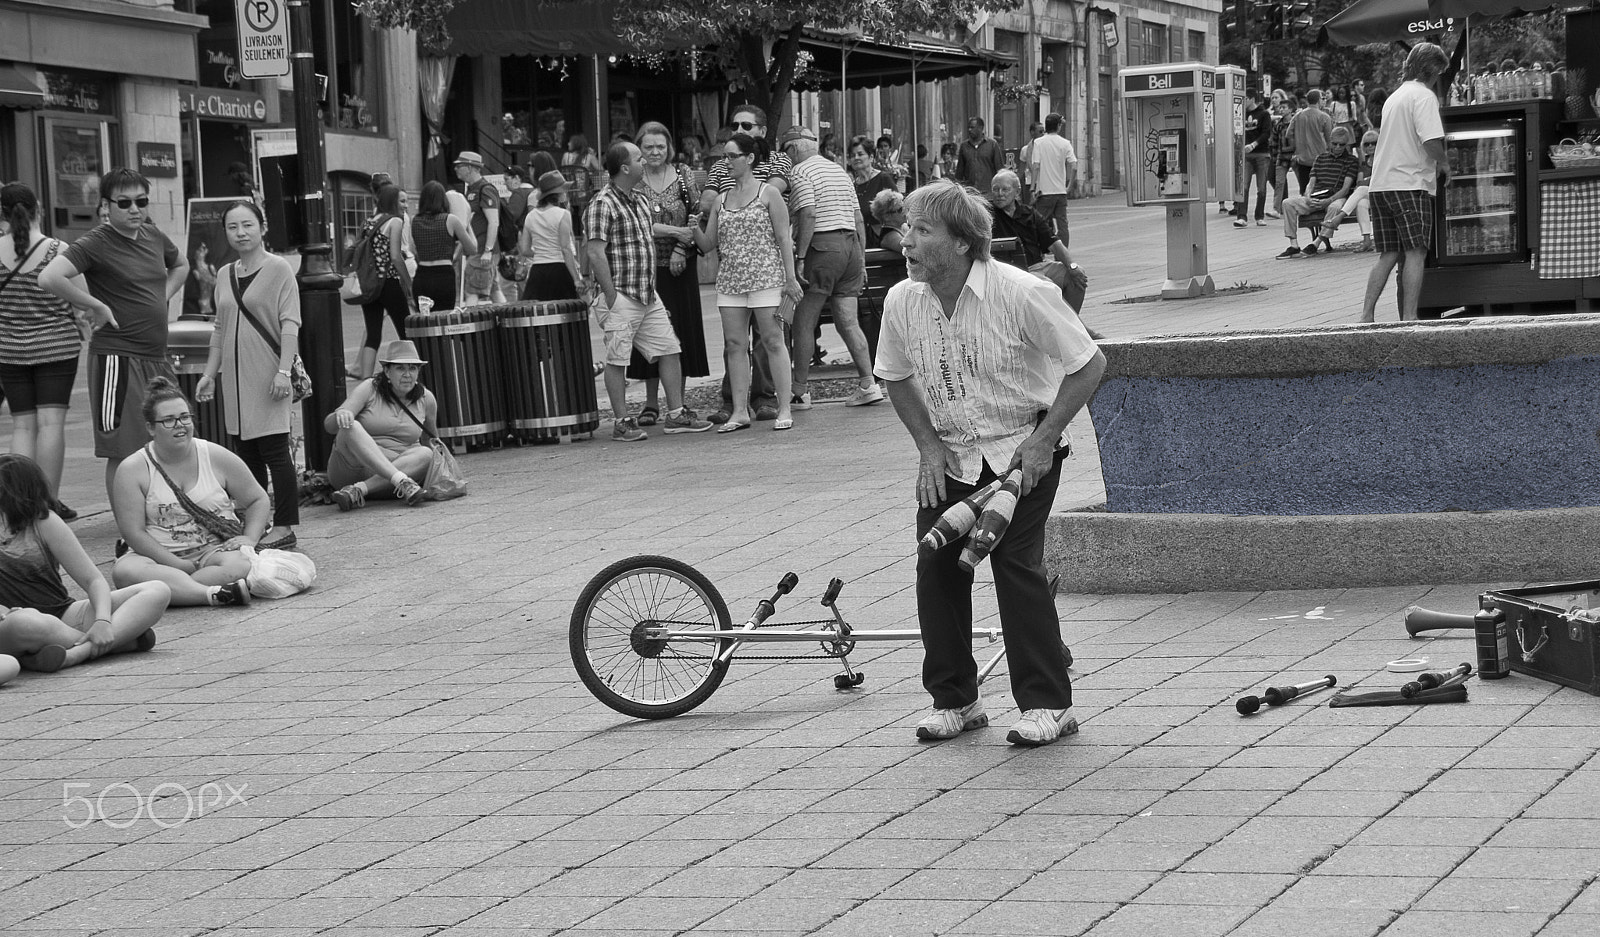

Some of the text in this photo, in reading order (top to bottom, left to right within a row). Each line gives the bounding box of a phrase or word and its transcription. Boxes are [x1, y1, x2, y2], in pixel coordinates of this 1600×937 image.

[245, 35, 282, 47] LIVRAISON
[245, 48, 284, 60] SEULEMENT
[1148, 74, 1172, 89] Bell
[1202, 72, 1212, 87] Bell
[1233, 75, 1243, 89] Bell
[207, 95, 253, 119] Chariot
[939, 358, 956, 401] summer
